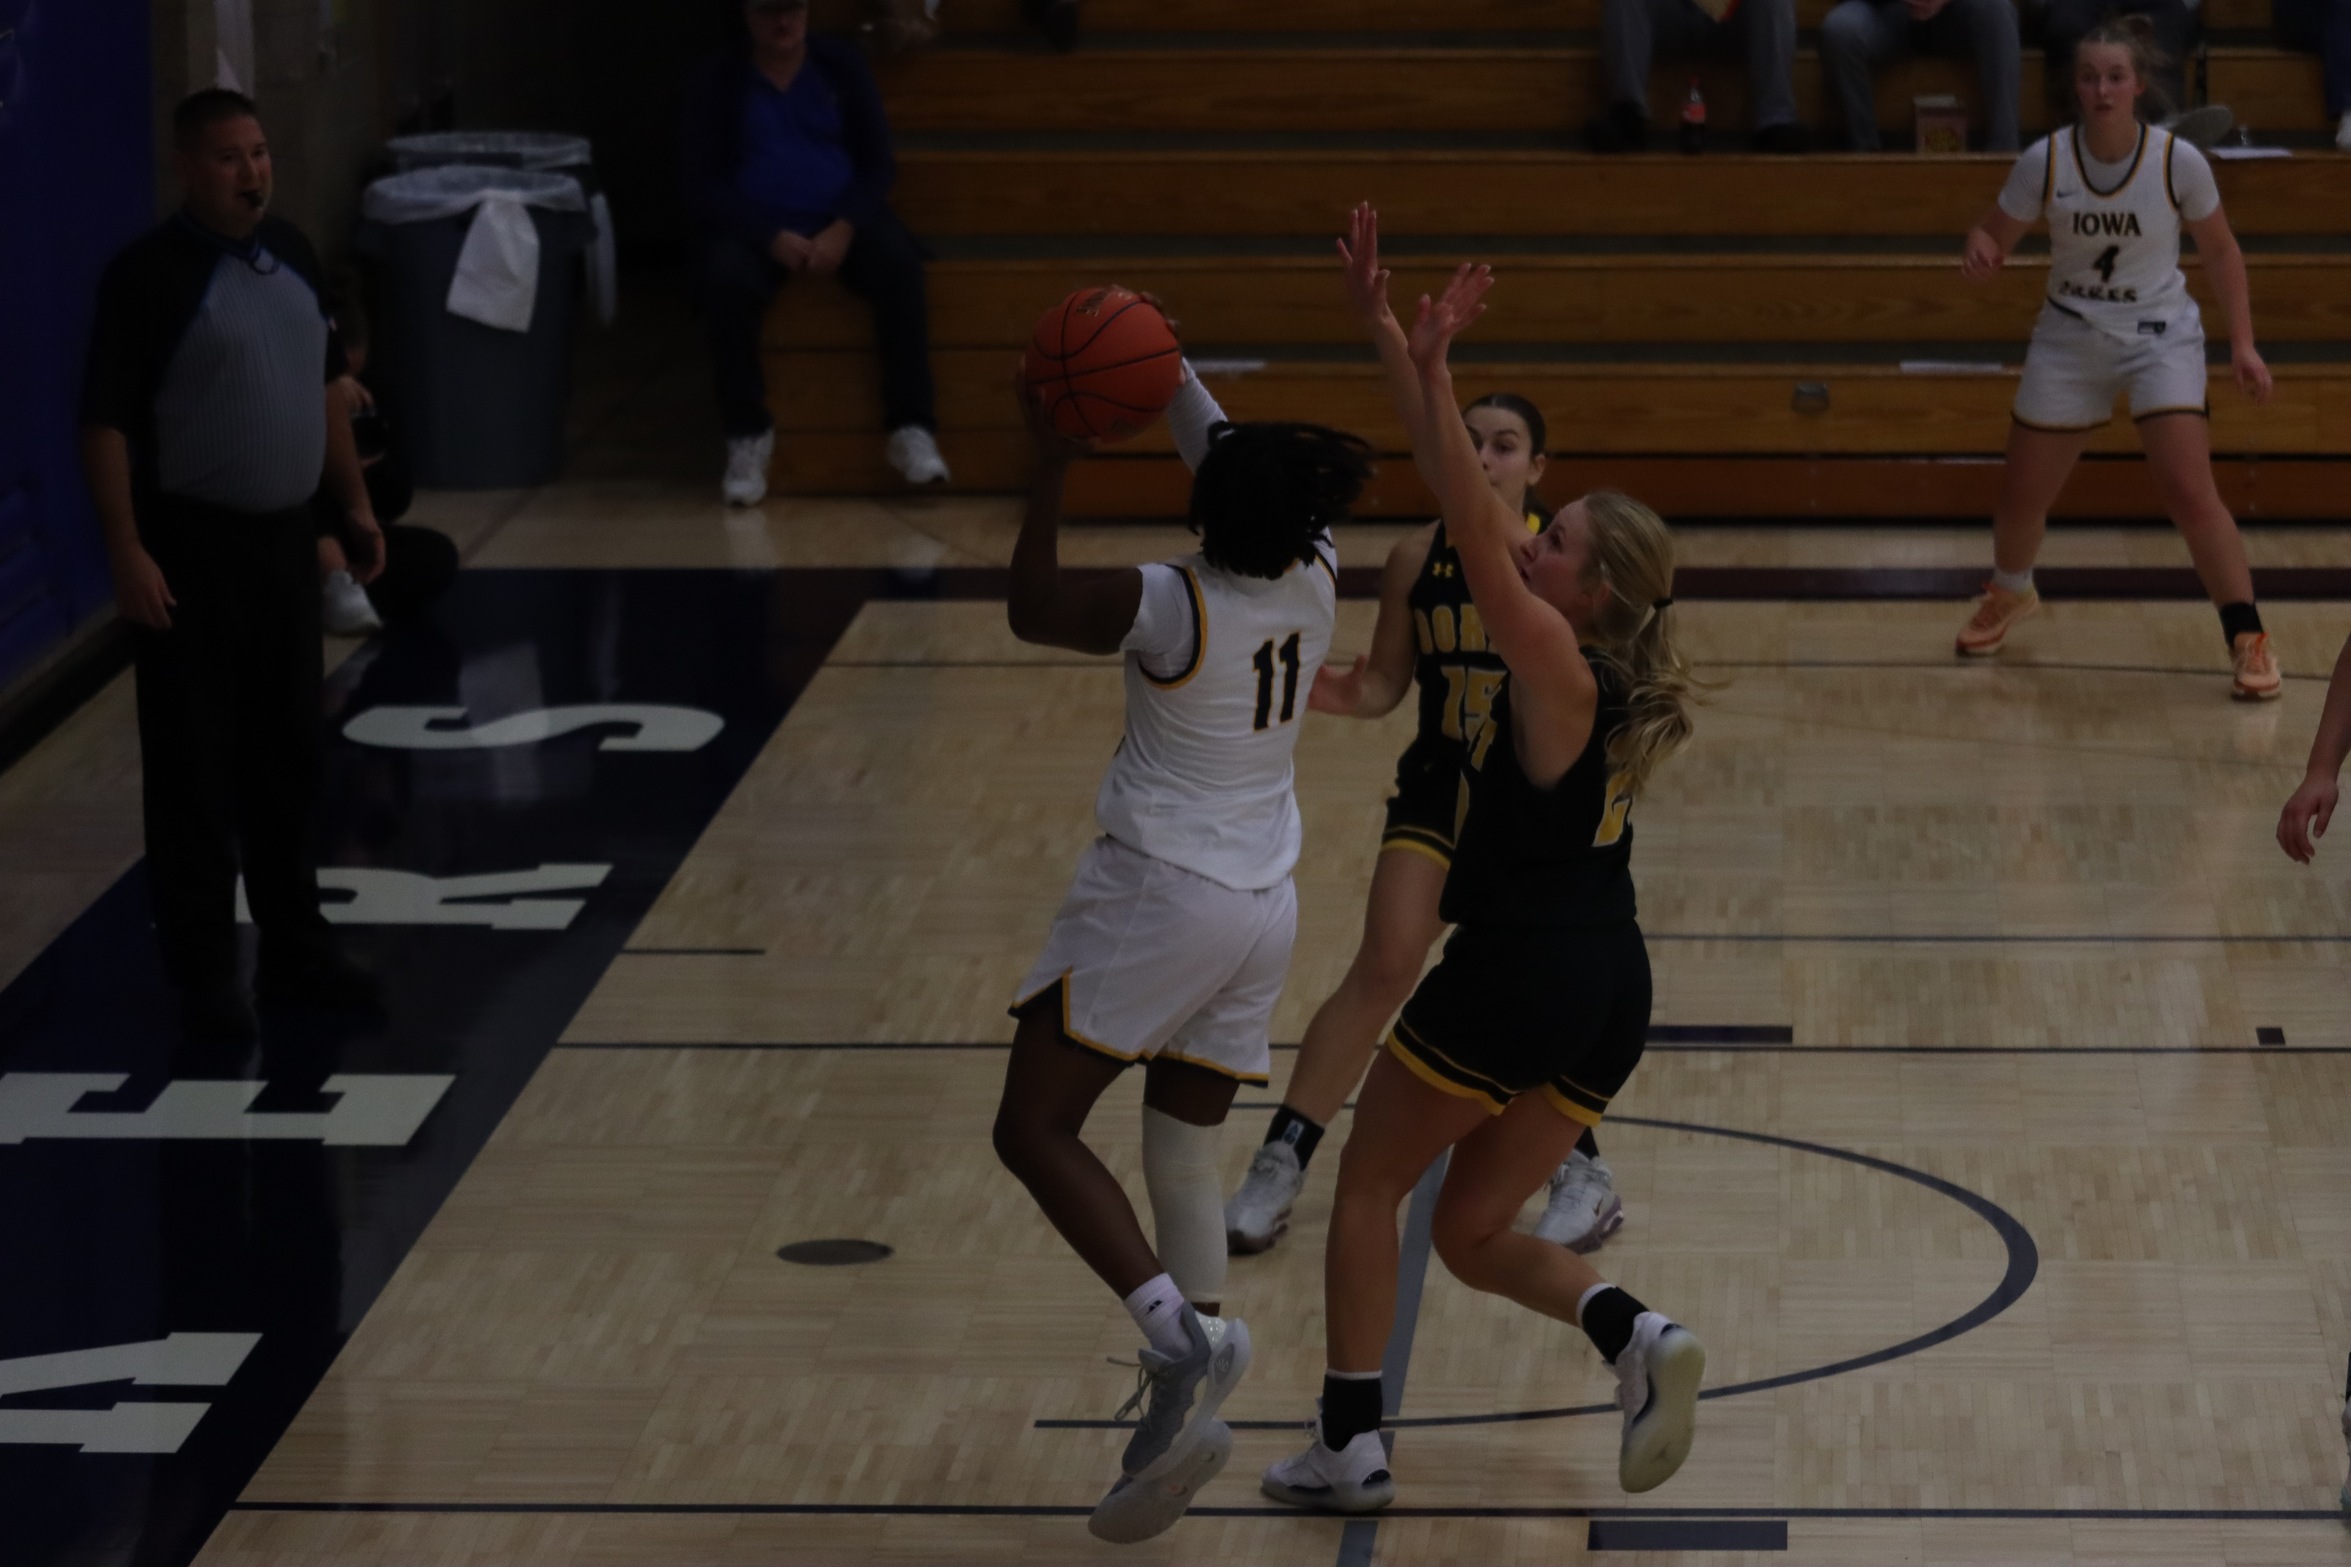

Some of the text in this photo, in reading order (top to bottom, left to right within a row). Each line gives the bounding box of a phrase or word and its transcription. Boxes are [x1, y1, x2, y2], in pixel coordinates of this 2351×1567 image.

[2072, 211, 2142, 237] IOWA
[2093, 245, 2121, 284] 4
[1251, 630, 1300, 731] 11
